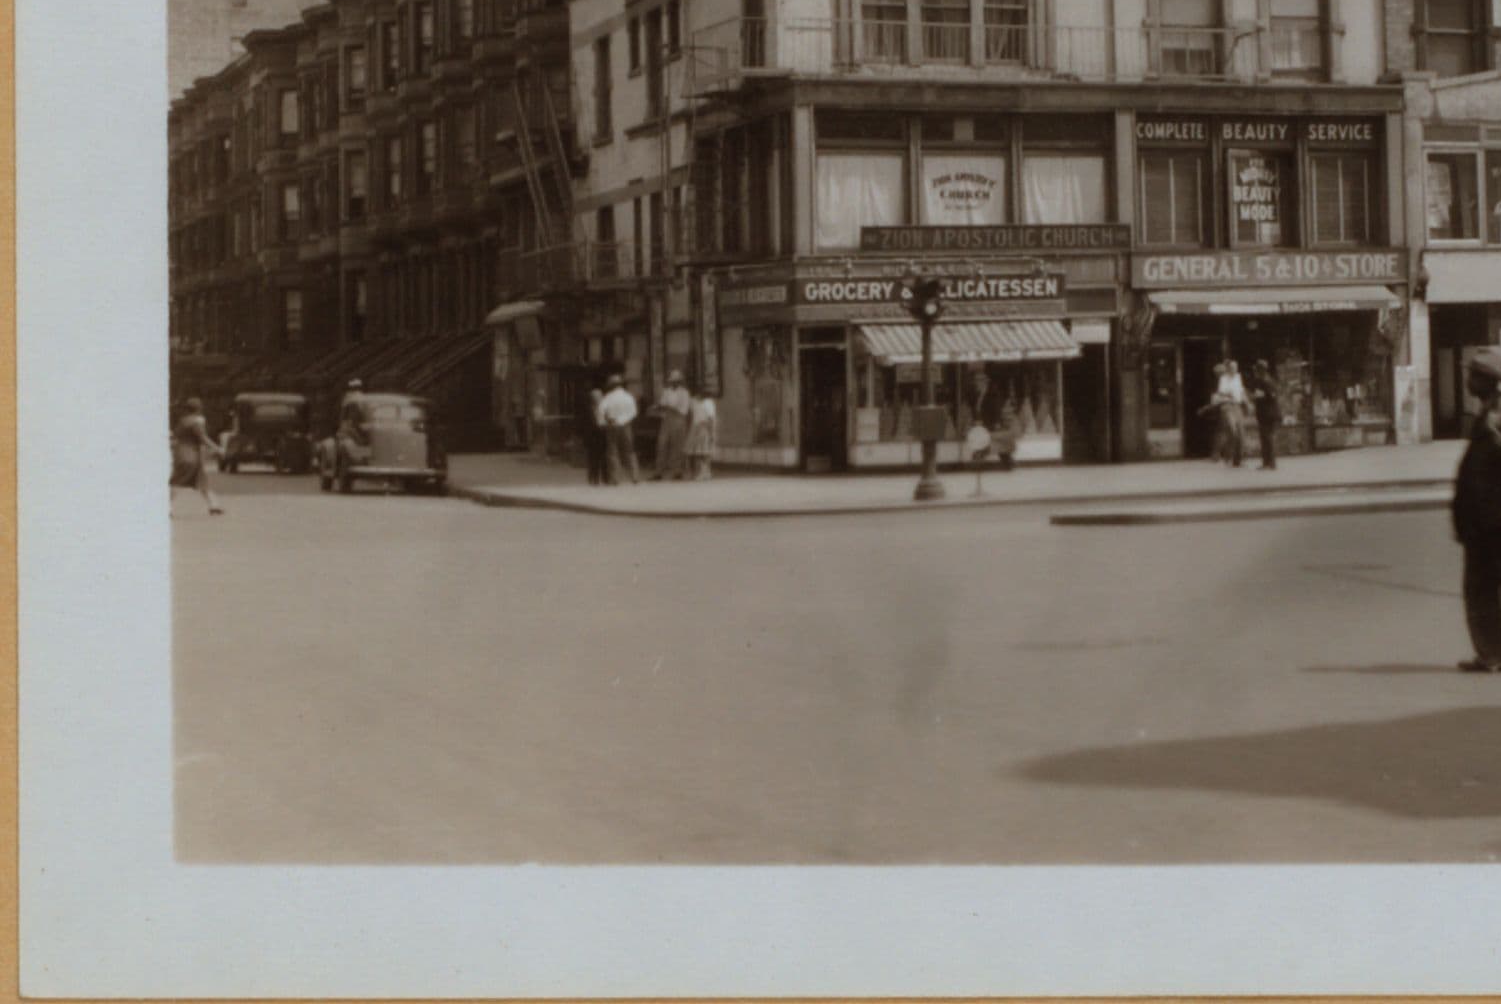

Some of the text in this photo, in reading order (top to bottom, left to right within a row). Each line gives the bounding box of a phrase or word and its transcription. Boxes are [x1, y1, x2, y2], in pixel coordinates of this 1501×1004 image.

[1136, 123, 1372, 140] COMPLETE BEAUTY SERVICE
[940, 190, 991, 200] CHURCH
[1234, 186, 1280, 202] BEAUTY
[881, 227, 1113, 248] ZION APOSTOLIC CHURCH
[1143, 255, 1248, 281] GENERAL
[1335, 253, 1399, 278] STORE
[805, 282, 894, 300] GROCERY
[939, 278, 1058, 299] LICATESSEN
